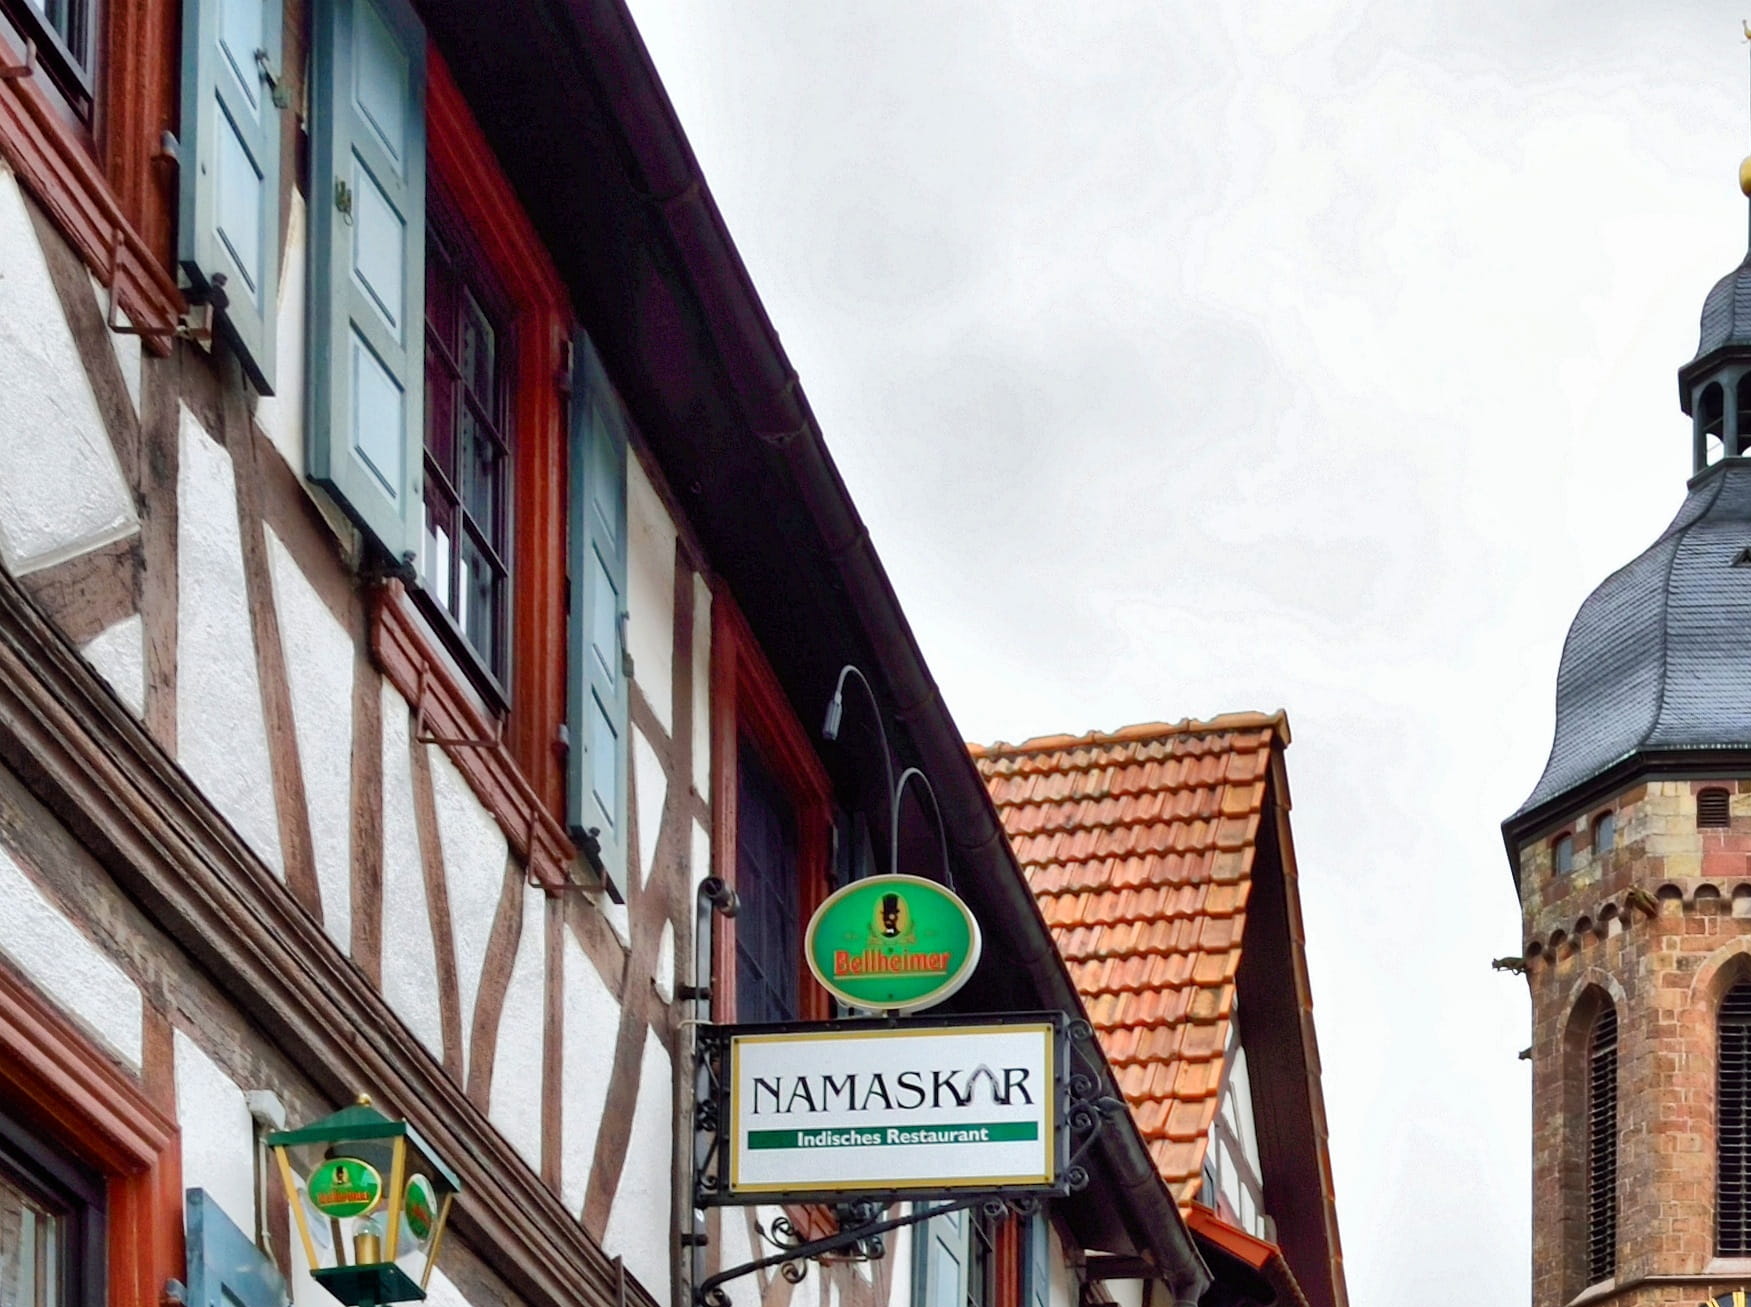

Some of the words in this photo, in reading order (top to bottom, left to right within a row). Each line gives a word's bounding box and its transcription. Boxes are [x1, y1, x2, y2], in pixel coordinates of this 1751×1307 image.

[834, 949, 950, 976] Bellheimer
[751, 1063, 1036, 1115] NAMASKAR
[797, 1130, 882, 1148] Indisches
[887, 1126, 989, 1145] Restaurant
